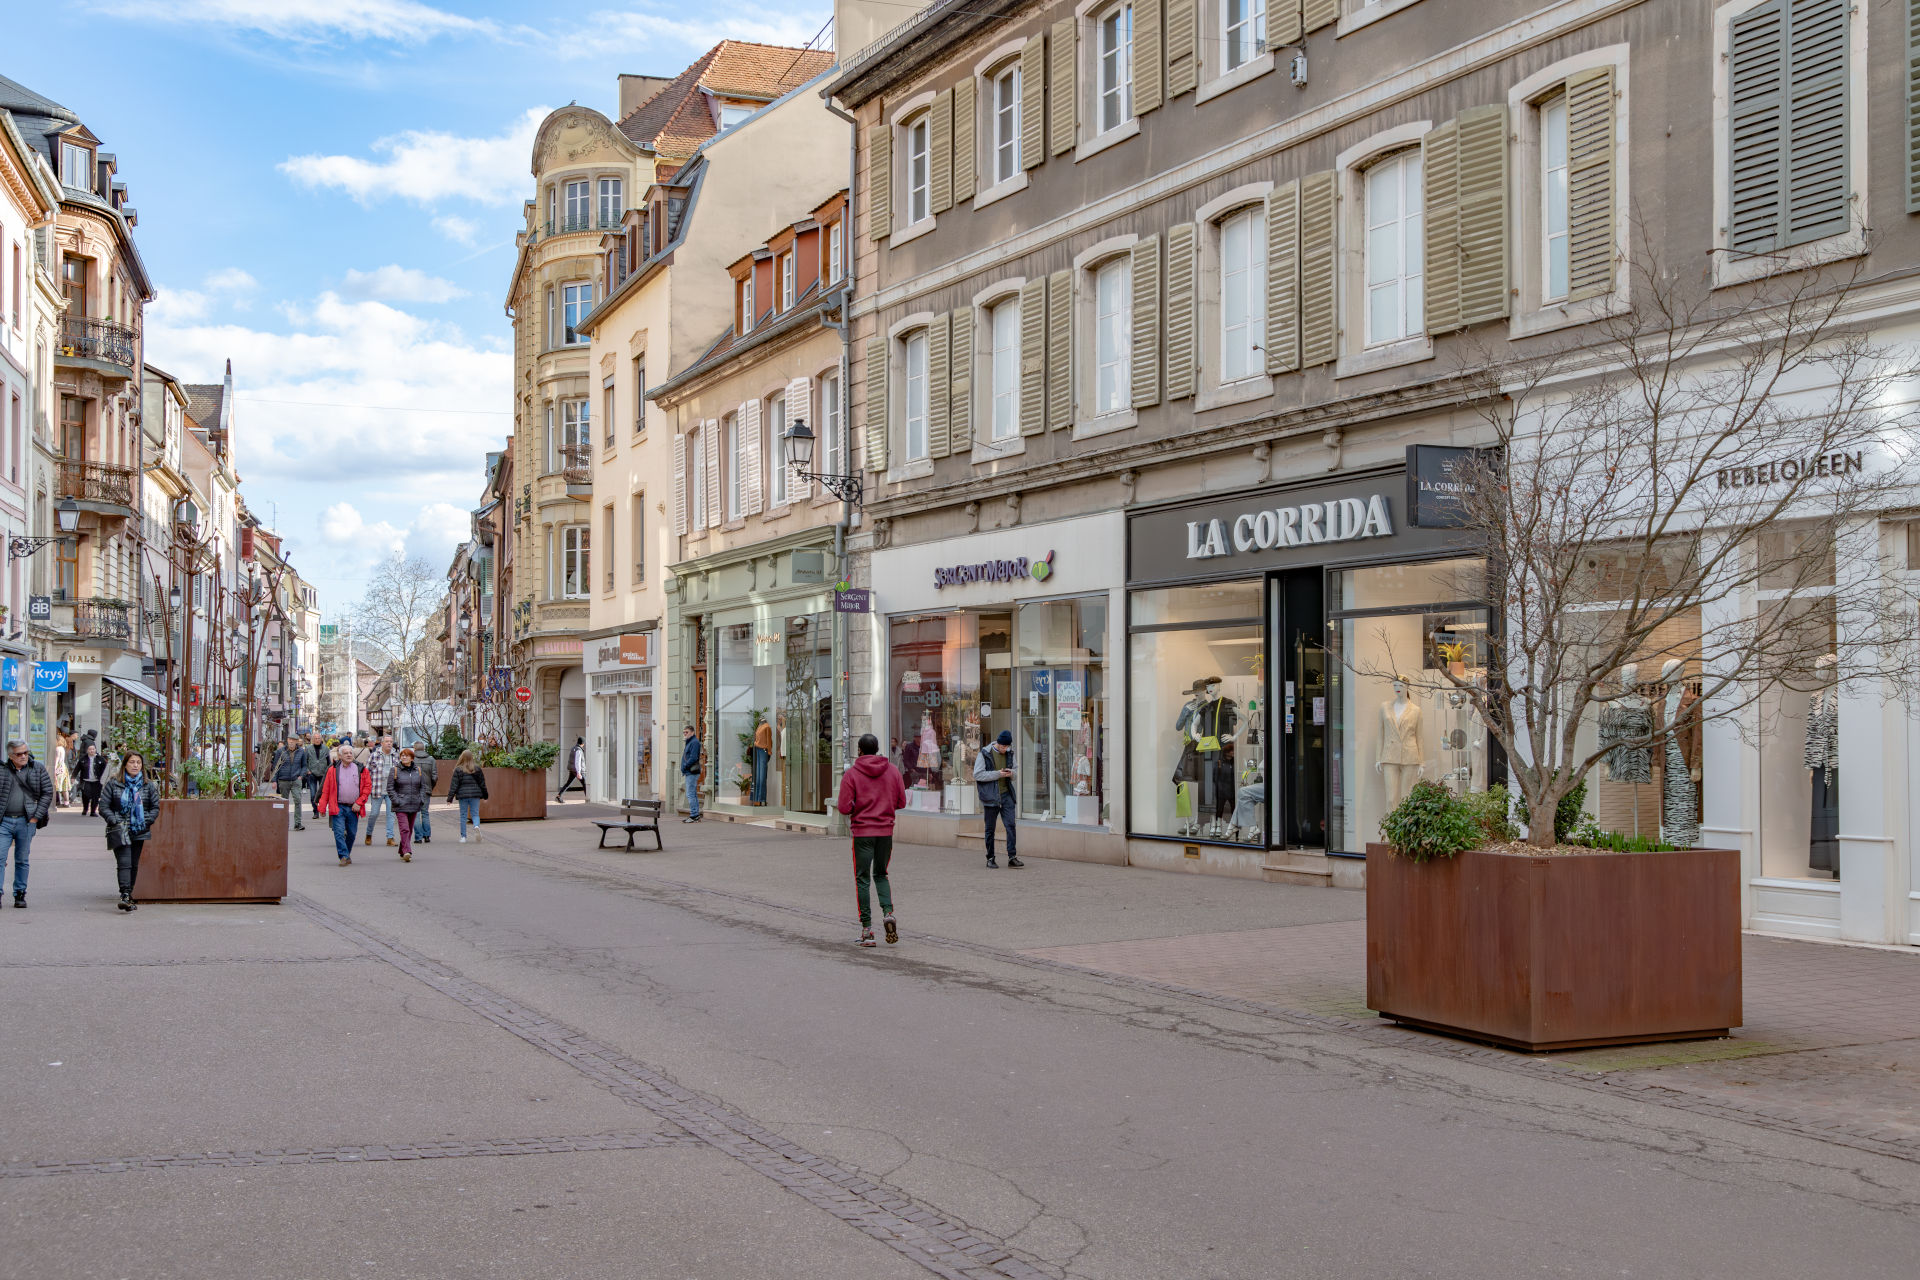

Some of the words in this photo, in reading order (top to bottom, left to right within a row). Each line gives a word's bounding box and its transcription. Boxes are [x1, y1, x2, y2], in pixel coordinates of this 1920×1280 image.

[1716, 451, 1863, 490] REBELQUEEN
[1420, 481, 1432, 491] LA
[1434, 482, 1476, 493] CORRDA
[1186, 518, 1227, 559] LA
[1233, 494, 1393, 552] CORRIDA
[36, 668, 63, 682] Krys
